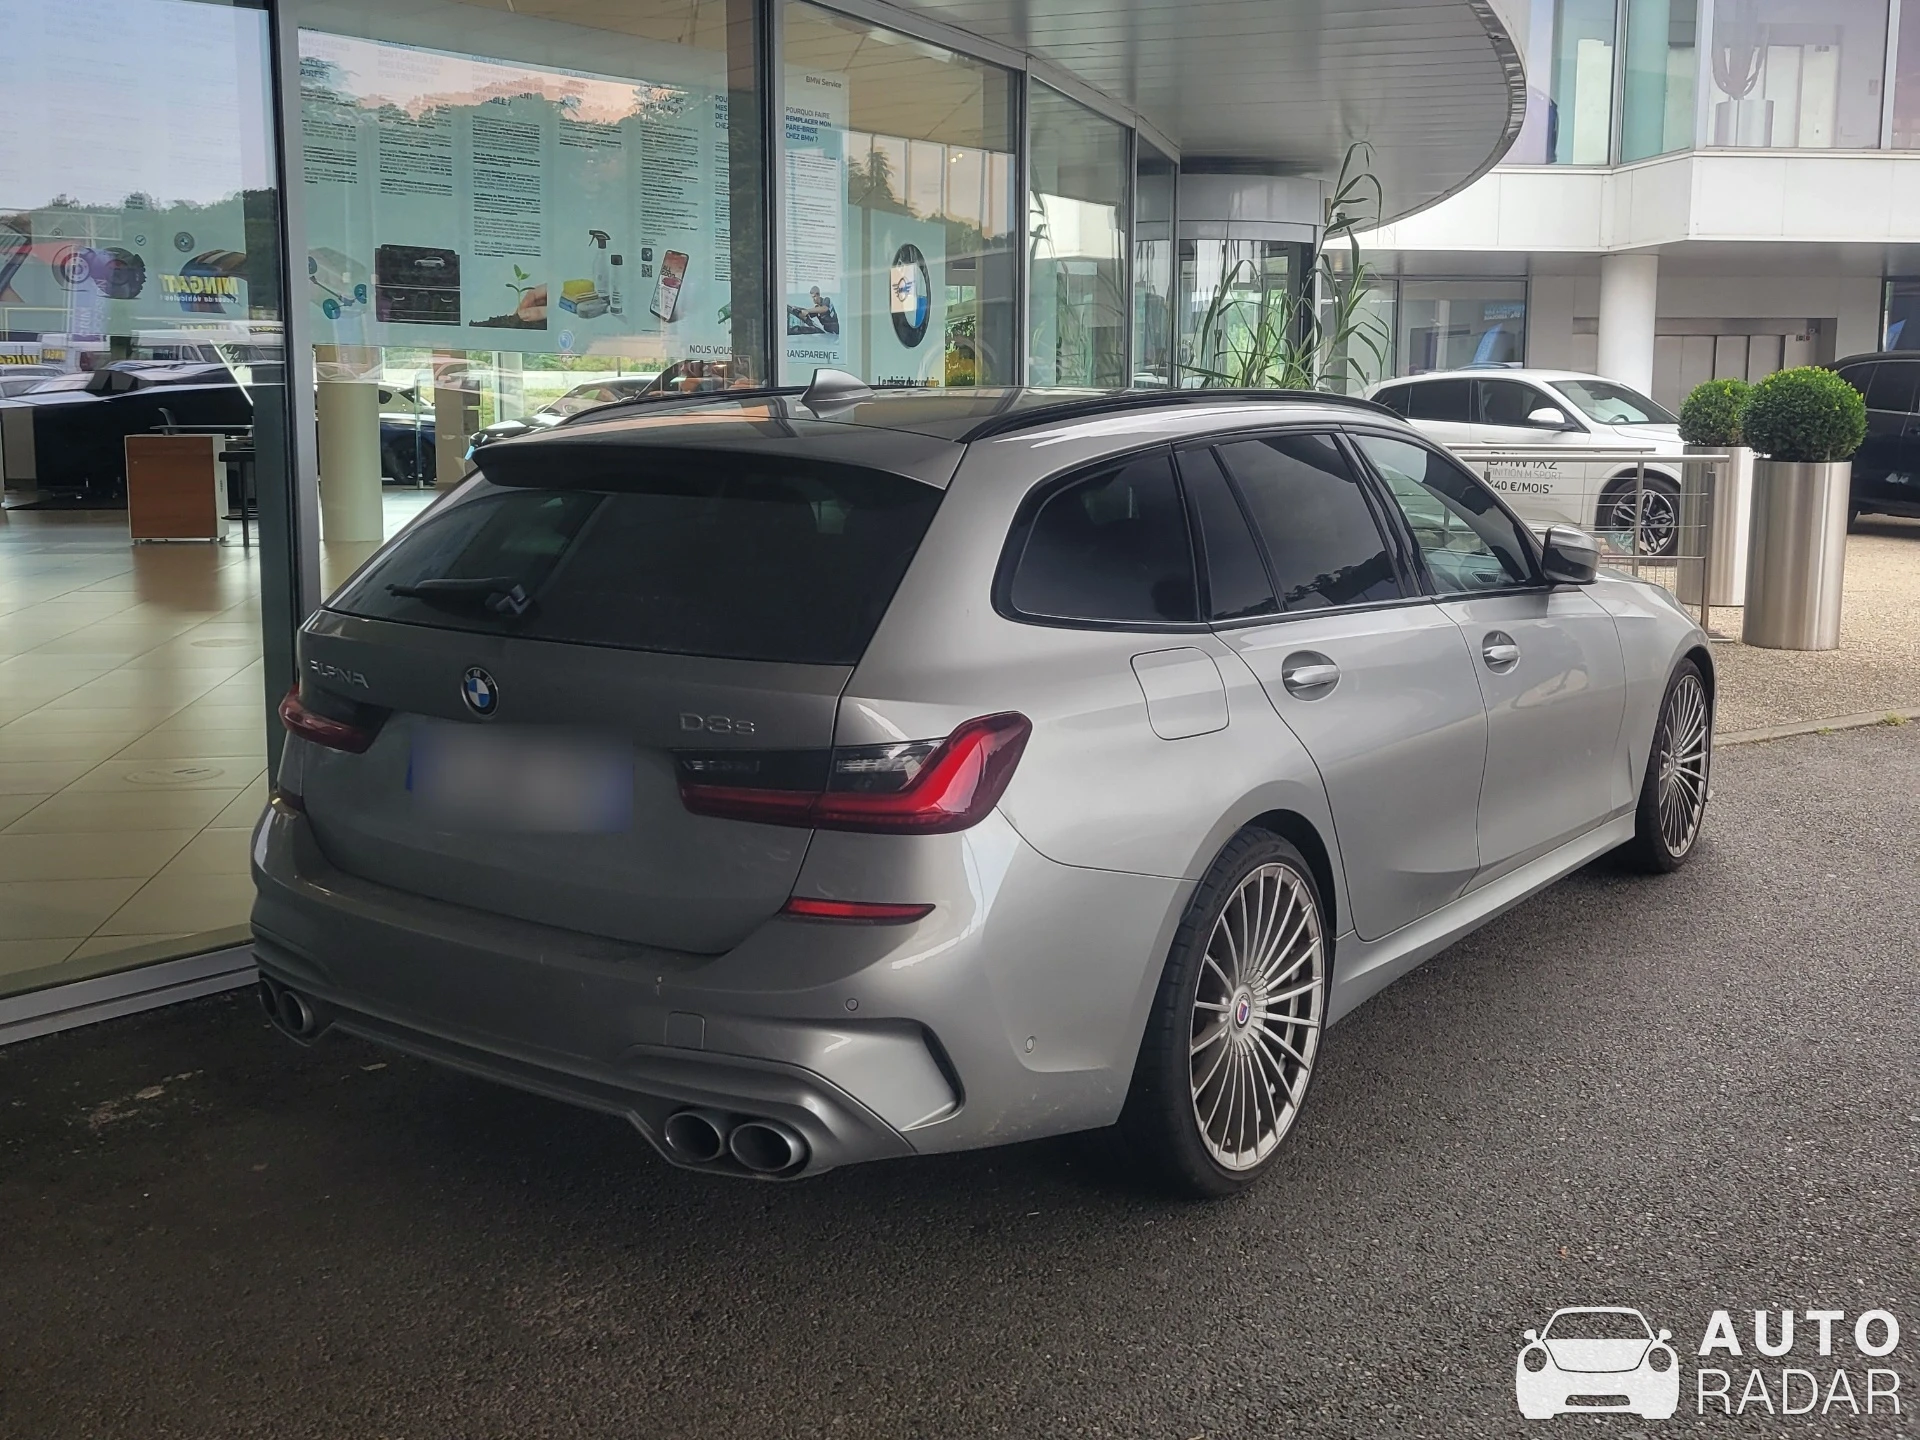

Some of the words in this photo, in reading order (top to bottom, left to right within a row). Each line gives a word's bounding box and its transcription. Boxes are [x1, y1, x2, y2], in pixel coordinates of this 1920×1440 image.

[805, 75, 821, 85] BMW
[821, 78, 842, 89] Service
[786, 106, 814, 117] POURQUOI
[814, 111, 831, 120] FAIRE
[785, 114, 819, 126] REMPLACER
[819, 120, 832, 128] MON
[785, 123, 819, 135] PARE-BRISE
[785, 132, 800, 140] CHEZ
[689, 345, 712, 354] NOUS
[713, 346, 734, 355] VOUS
[1534, 470, 1562, 480] SPORT
[310, 659, 370, 689] ALPINA
